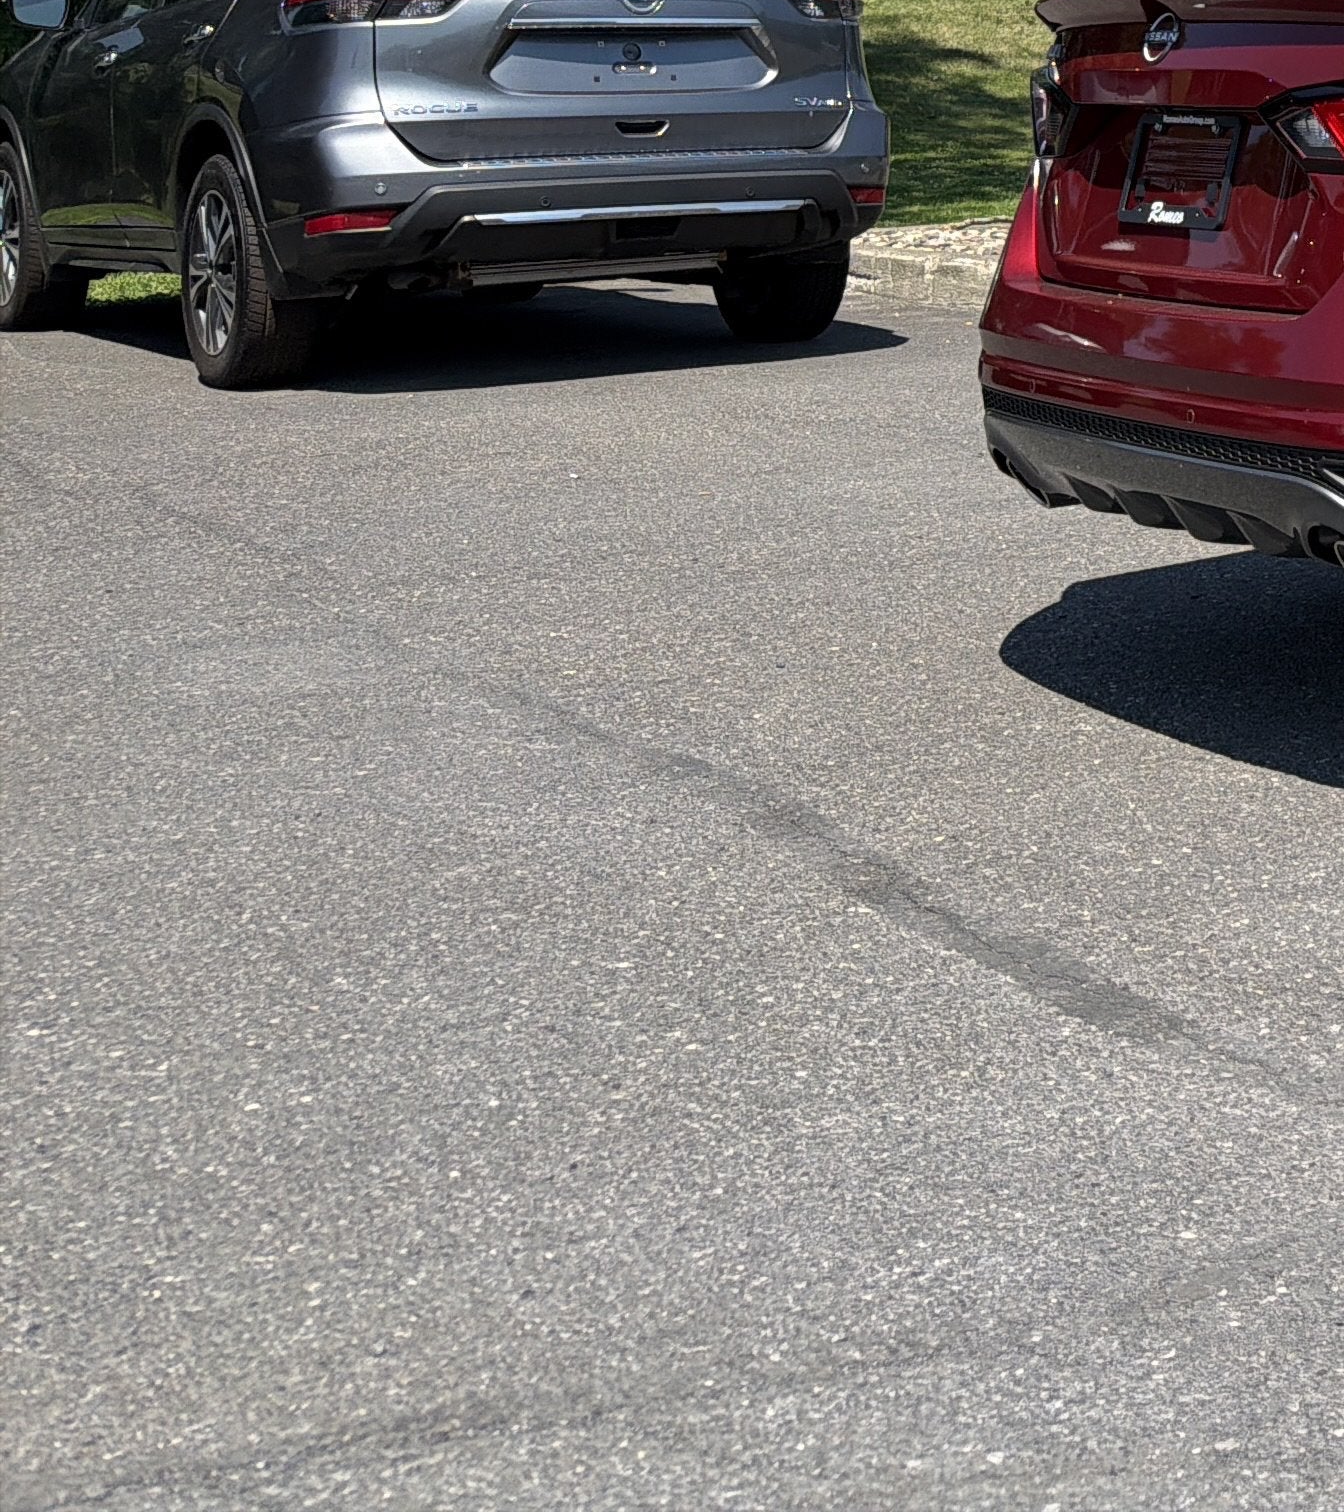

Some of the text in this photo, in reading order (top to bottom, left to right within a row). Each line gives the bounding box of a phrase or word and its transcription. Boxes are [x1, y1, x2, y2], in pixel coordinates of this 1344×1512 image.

[1145, 31, 1180, 42] ISSAN
[391, 99, 479, 115] ROGUE
[794, 97, 818, 106] SV
[1147, 201, 1185, 224] Romeo
